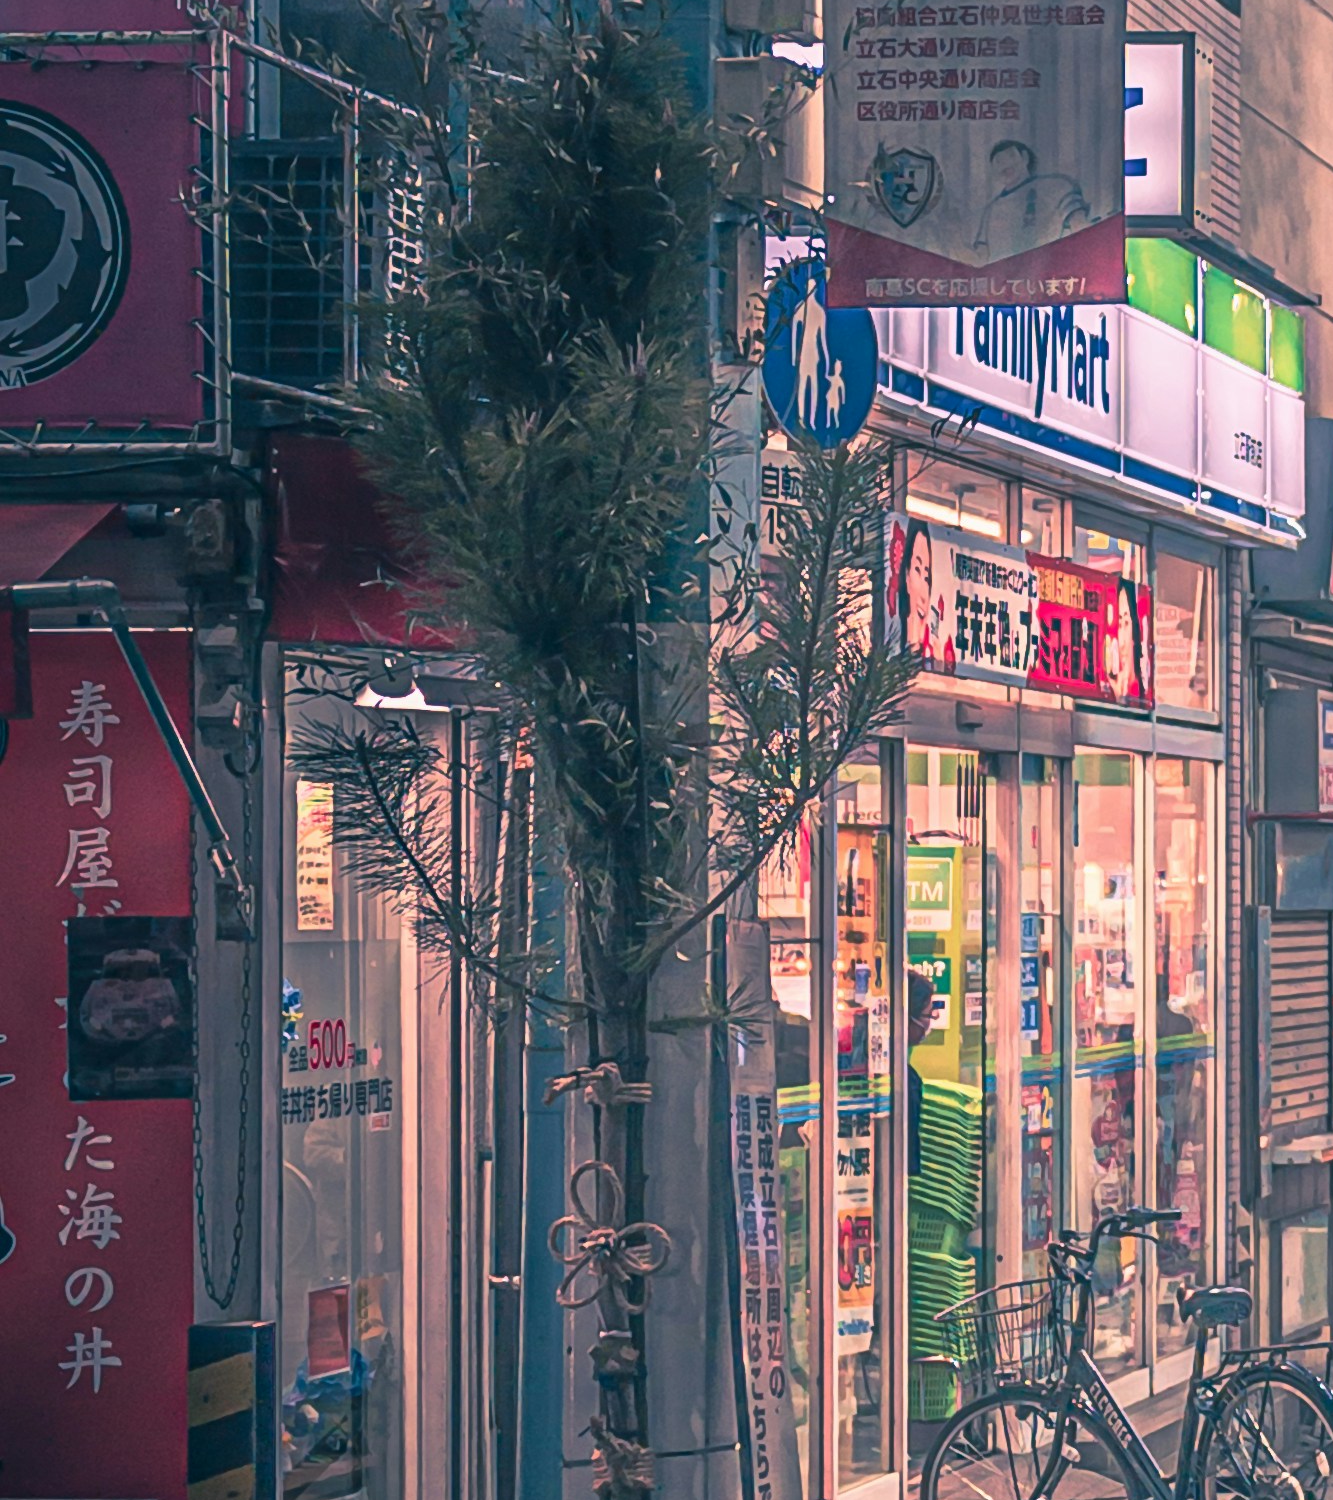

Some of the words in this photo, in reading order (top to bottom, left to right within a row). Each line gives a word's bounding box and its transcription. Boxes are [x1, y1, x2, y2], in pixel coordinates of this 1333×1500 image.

[856, 36, 1019, 59] 立石大通り商店会
[857, 67, 1041, 91] 立石中央通り商店会
[857, 98, 1021, 122] 区役所通り商店会
[56, 679, 124, 1395] 寿司屋た海の丼
